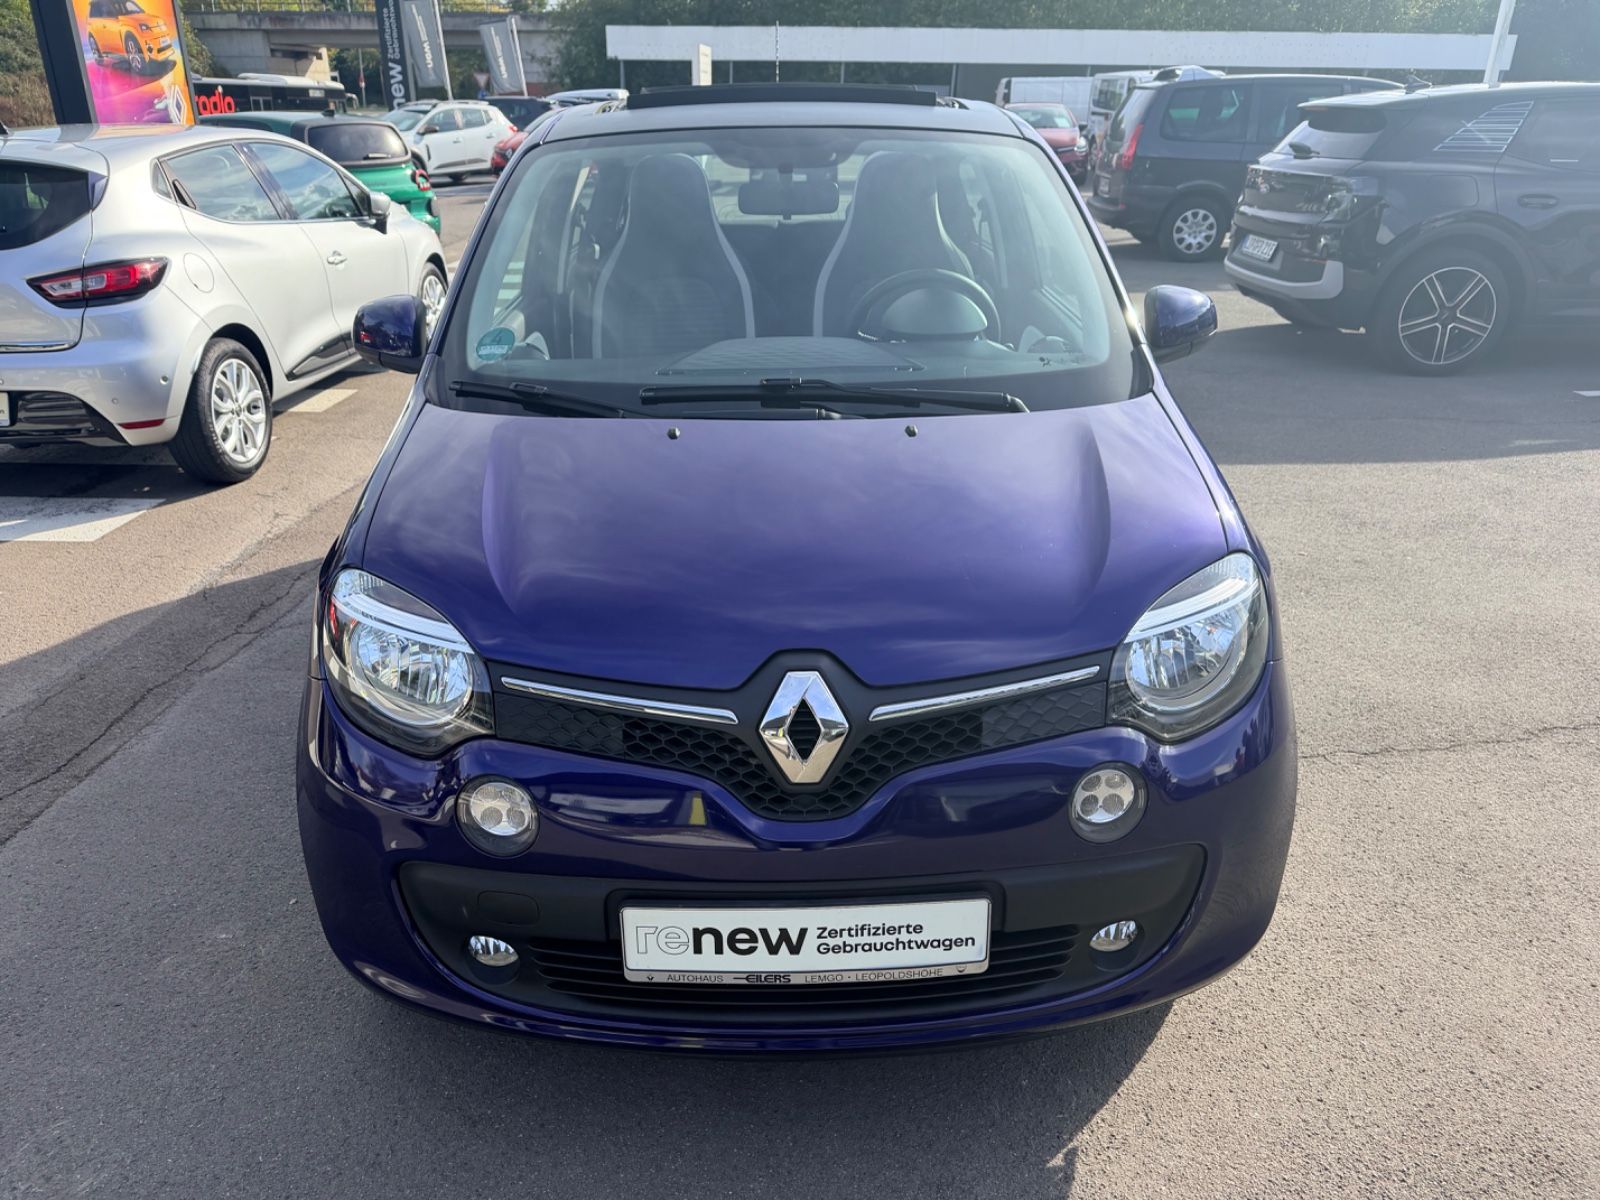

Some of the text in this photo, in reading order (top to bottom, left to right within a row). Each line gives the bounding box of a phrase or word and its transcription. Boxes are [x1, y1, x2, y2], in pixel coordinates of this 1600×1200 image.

[635, 923, 923, 956] renew Zertifizierte
[816, 936, 976, 955] Gebrauchtwagen
[666, 974, 724, 983] AUTOHAUS
[745, 974, 792, 984] EILERS
[804, 973, 844, 983] LEMGO
